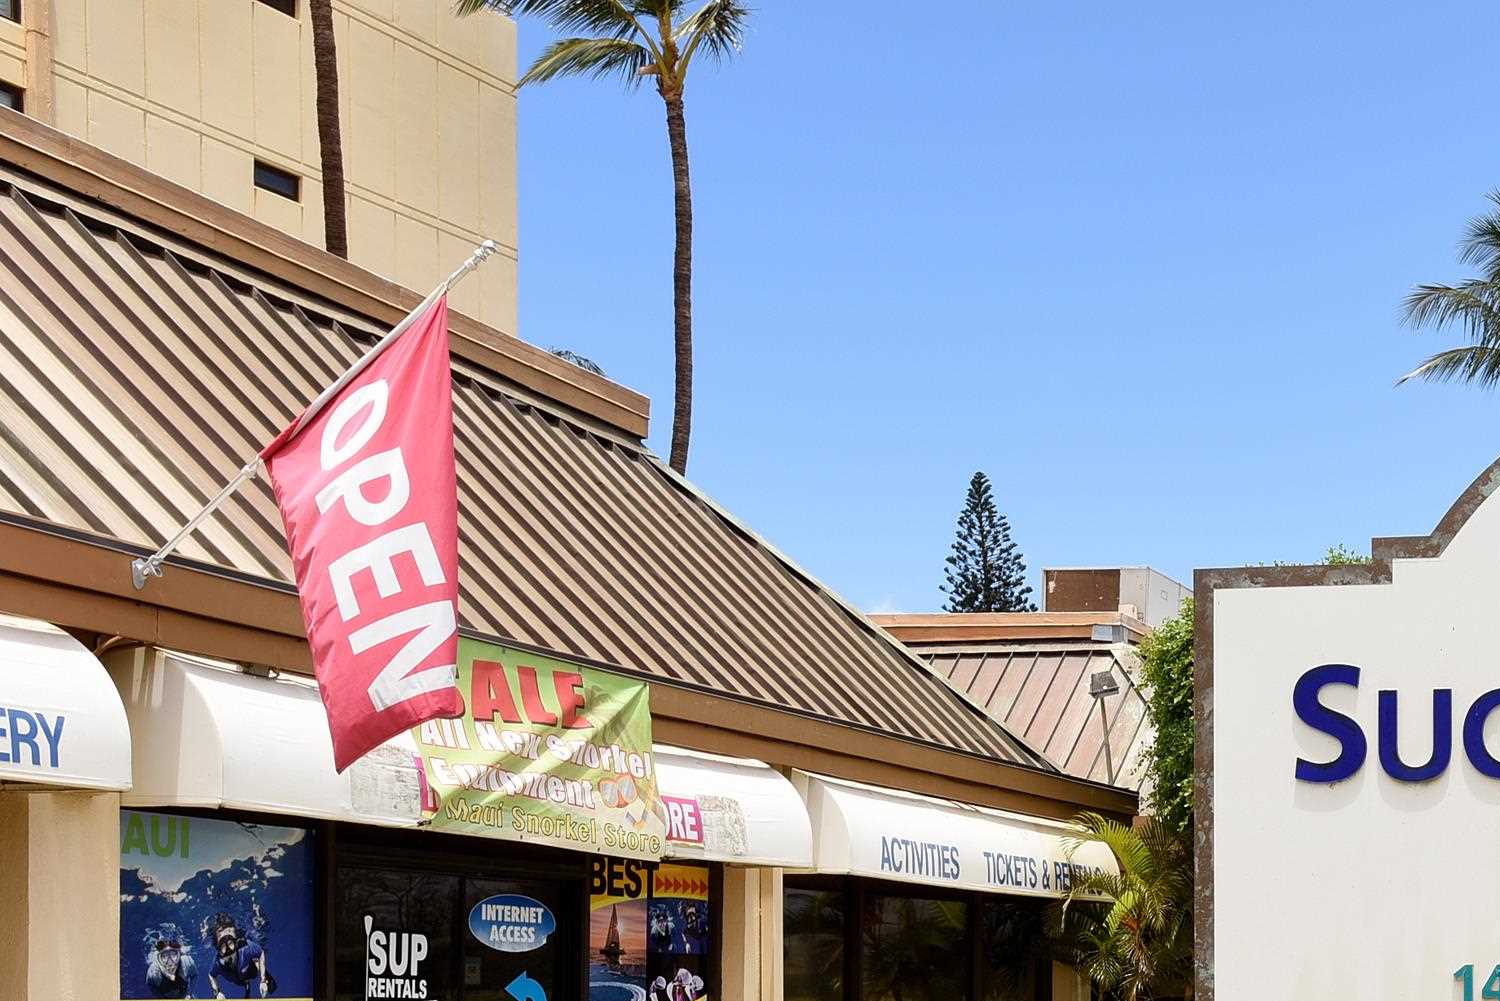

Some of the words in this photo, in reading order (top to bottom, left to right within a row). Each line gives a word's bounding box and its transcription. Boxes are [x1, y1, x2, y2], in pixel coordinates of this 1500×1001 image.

[315, 378, 457, 712] OPEN
[456, 659, 595, 729] ALE
[420, 716, 471, 750] All
[545, 733, 652, 780] Snorkel
[445, 797, 504, 828] Maui
[512, 805, 597, 845] Snorkel
[603, 822, 661, 854] Store
[591, 856, 659, 900] BEST
[880, 835, 960, 881] ACTIVITIES
[983, 851, 1037, 889] TICKETS
[1041, 859, 1050, 889] &
[481, 903, 544, 924] INTERNET
[489, 924, 536, 944] ACCESS
[368, 930, 428, 977] SUP
[368, 978, 428, 999] RENTALS
